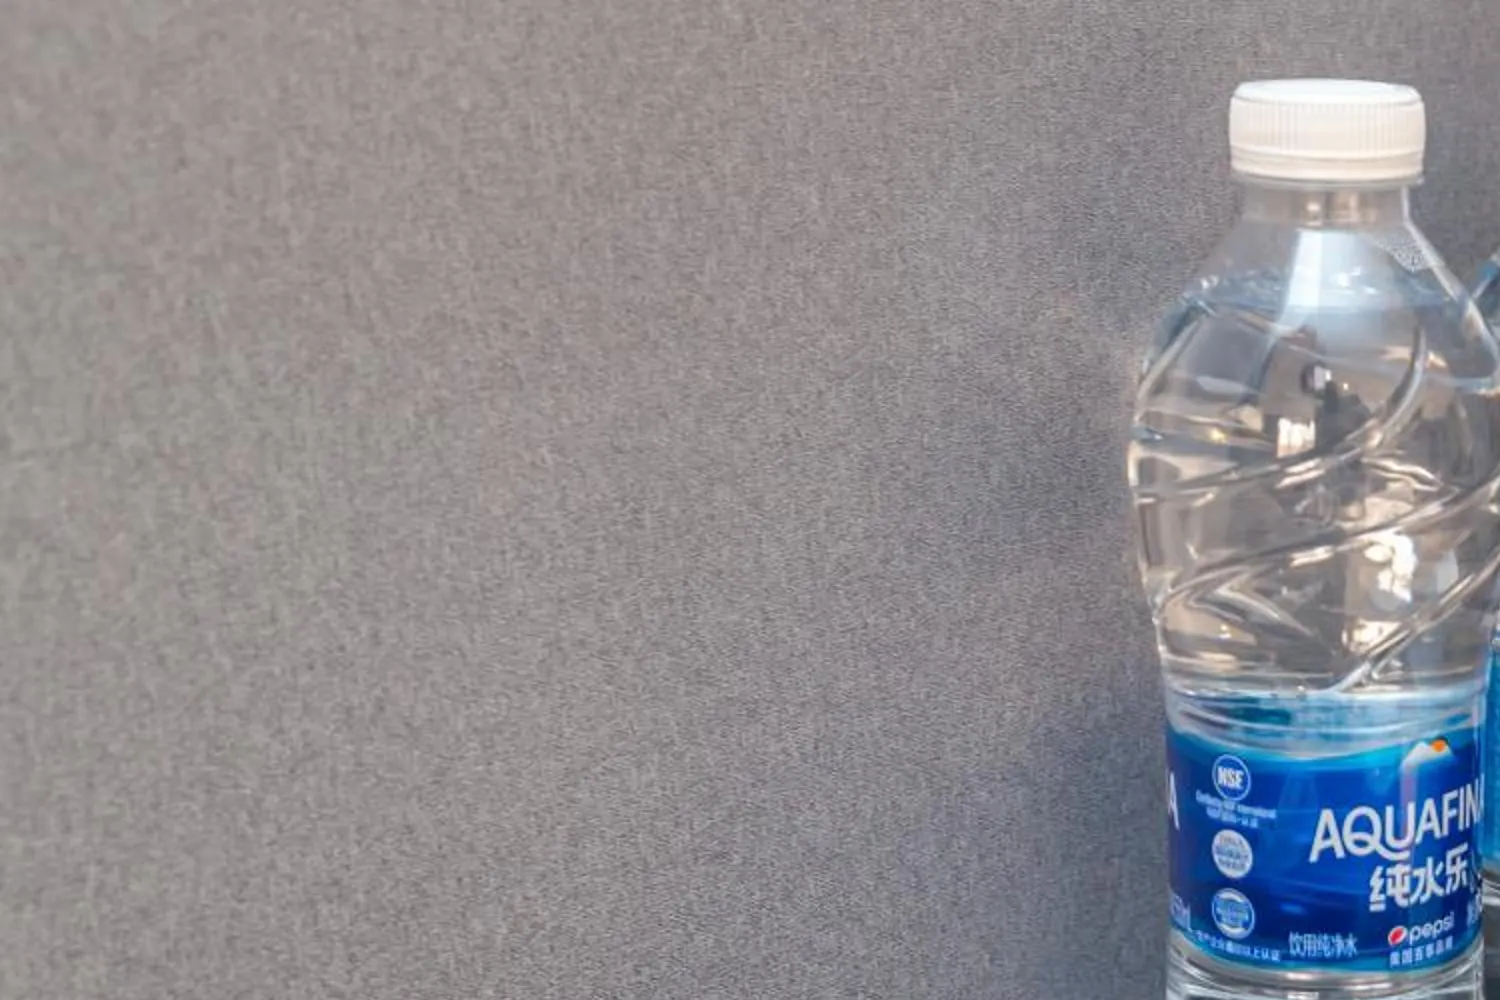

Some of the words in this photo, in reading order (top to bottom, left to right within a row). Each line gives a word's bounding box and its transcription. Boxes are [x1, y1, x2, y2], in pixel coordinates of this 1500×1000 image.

[1369, 842, 1468, 911] 纯水乐
[1409, 911, 1454, 945] pepsi
